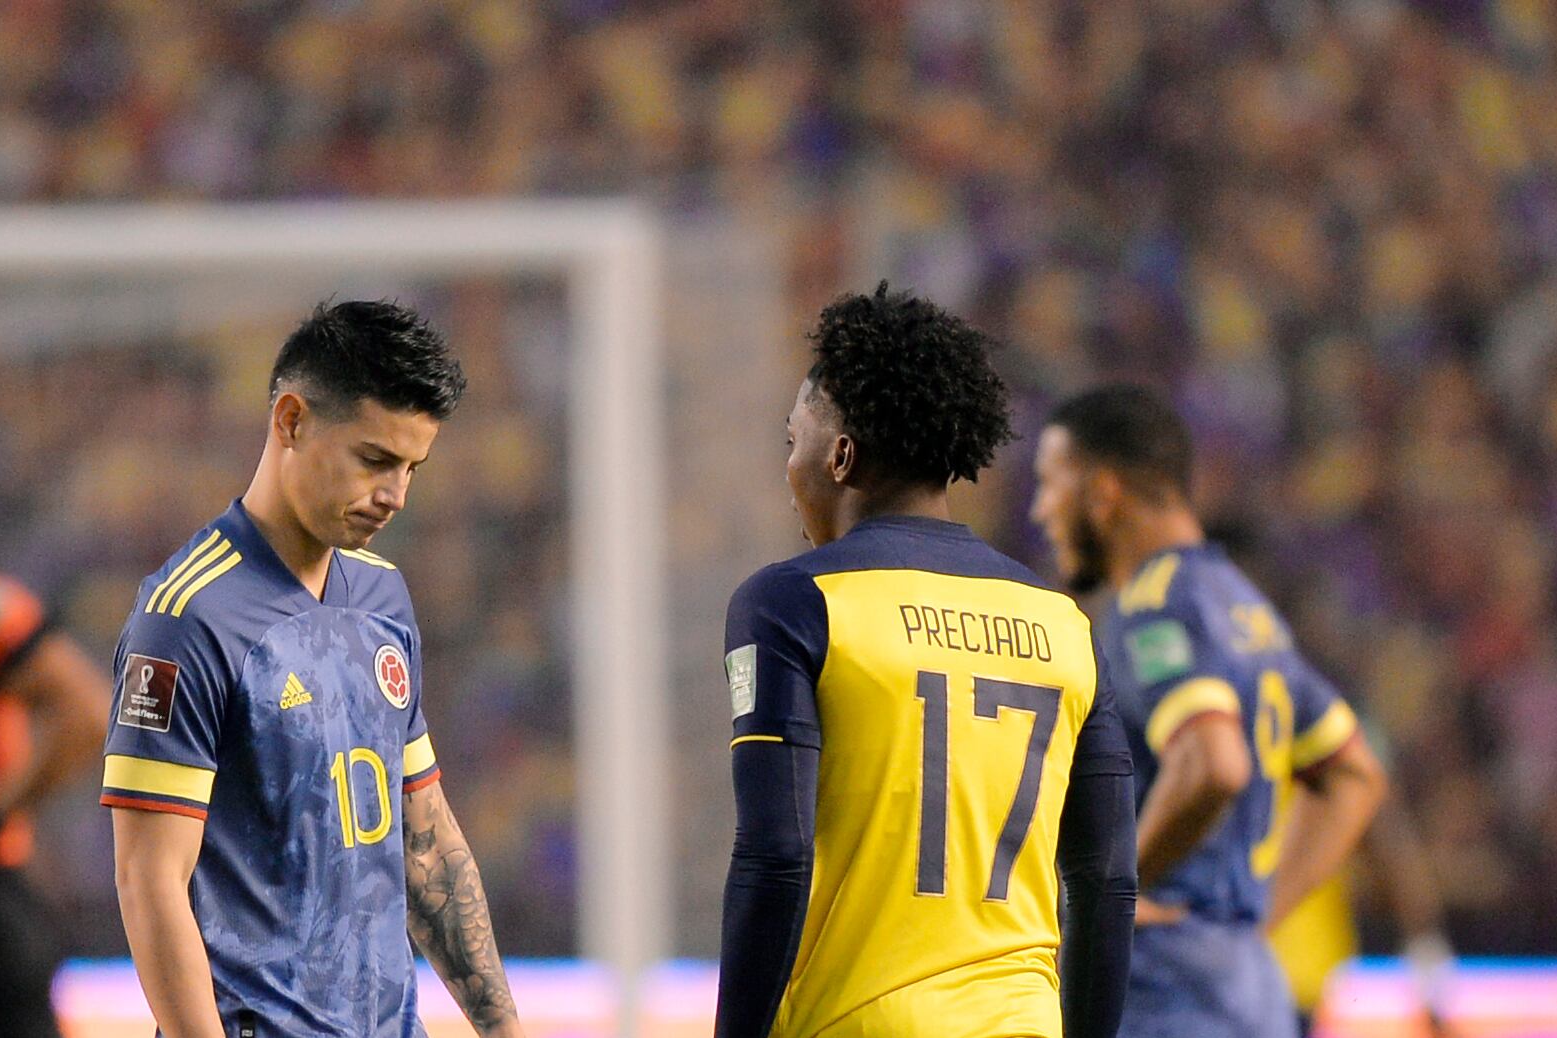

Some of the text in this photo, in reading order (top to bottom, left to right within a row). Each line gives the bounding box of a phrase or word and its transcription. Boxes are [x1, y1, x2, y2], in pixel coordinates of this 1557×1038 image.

[899, 604, 1052, 662] PRECIADO
[330, 746, 393, 849] 10
[914, 669, 1064, 904] 17
